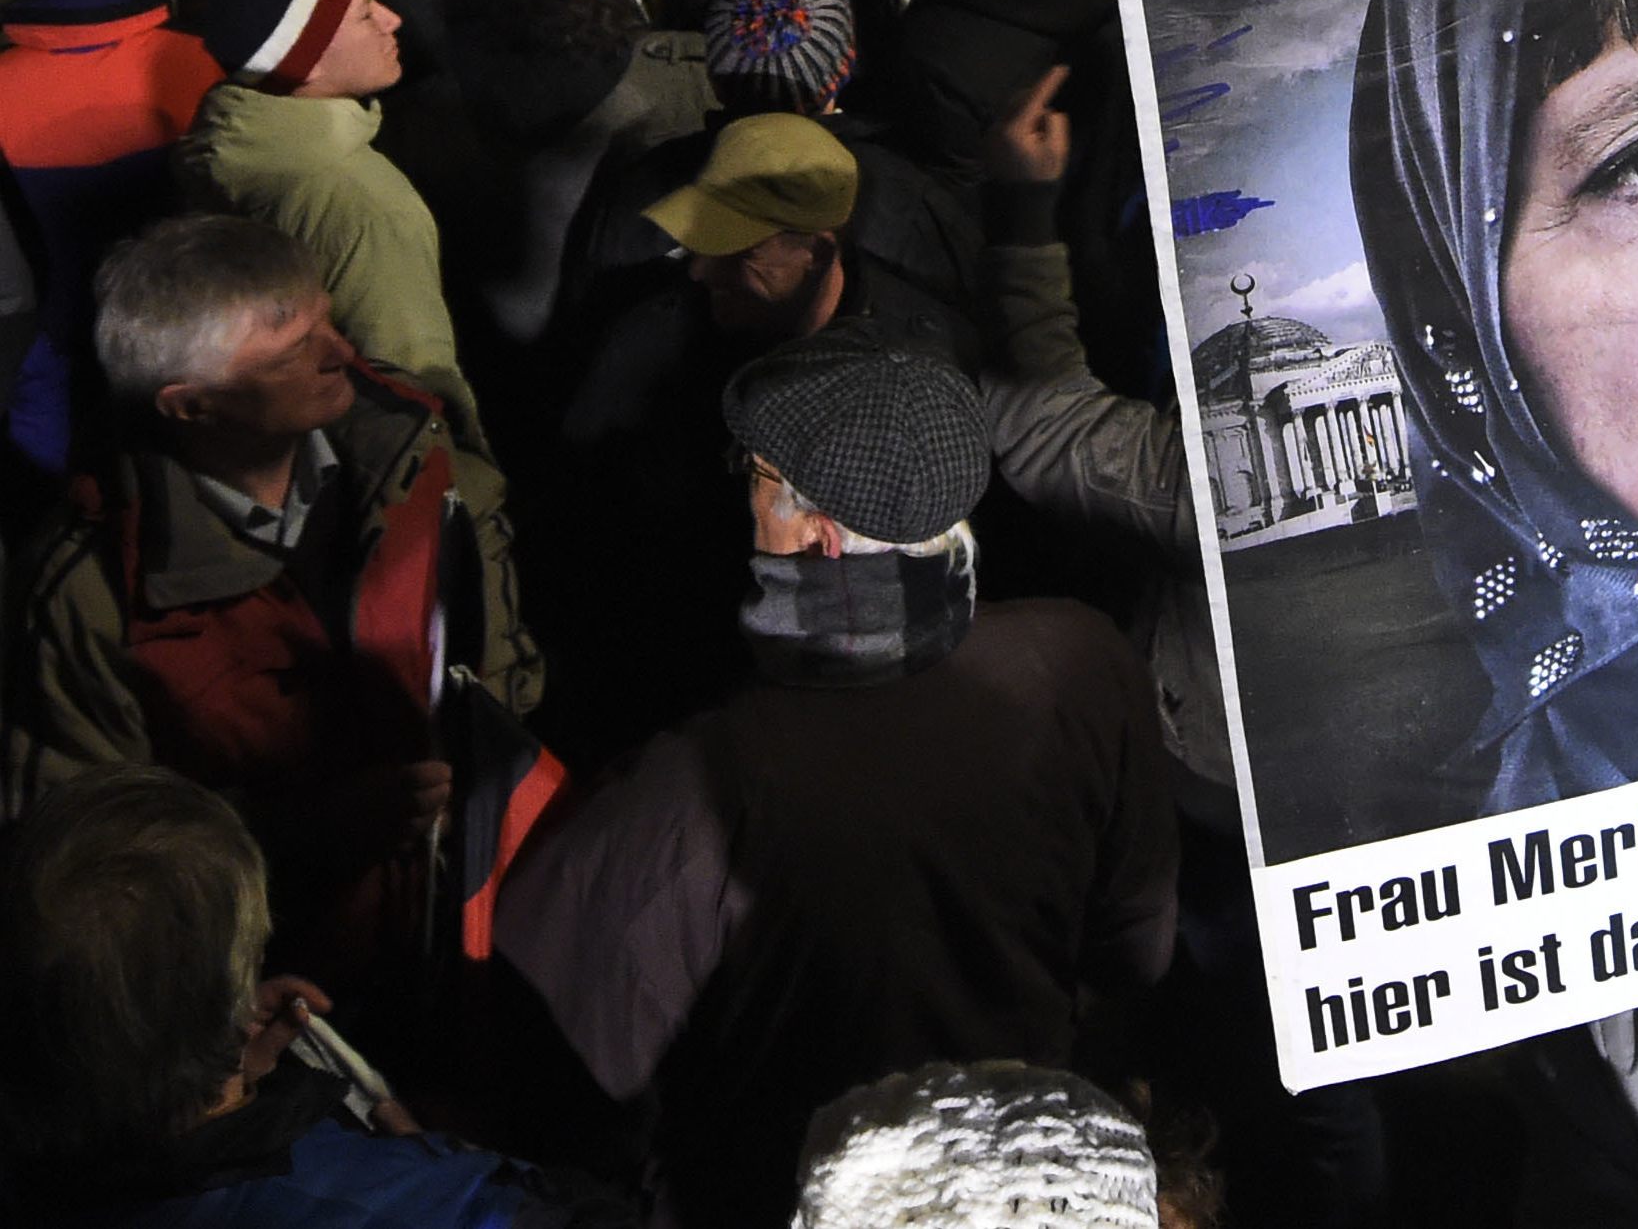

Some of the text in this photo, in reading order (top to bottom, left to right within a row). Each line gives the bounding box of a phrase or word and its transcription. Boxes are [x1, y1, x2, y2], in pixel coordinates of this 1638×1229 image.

[1293, 865, 1462, 951] Frau
[1305, 970, 1450, 1053] hier
[1478, 934, 1567, 1012] ist
